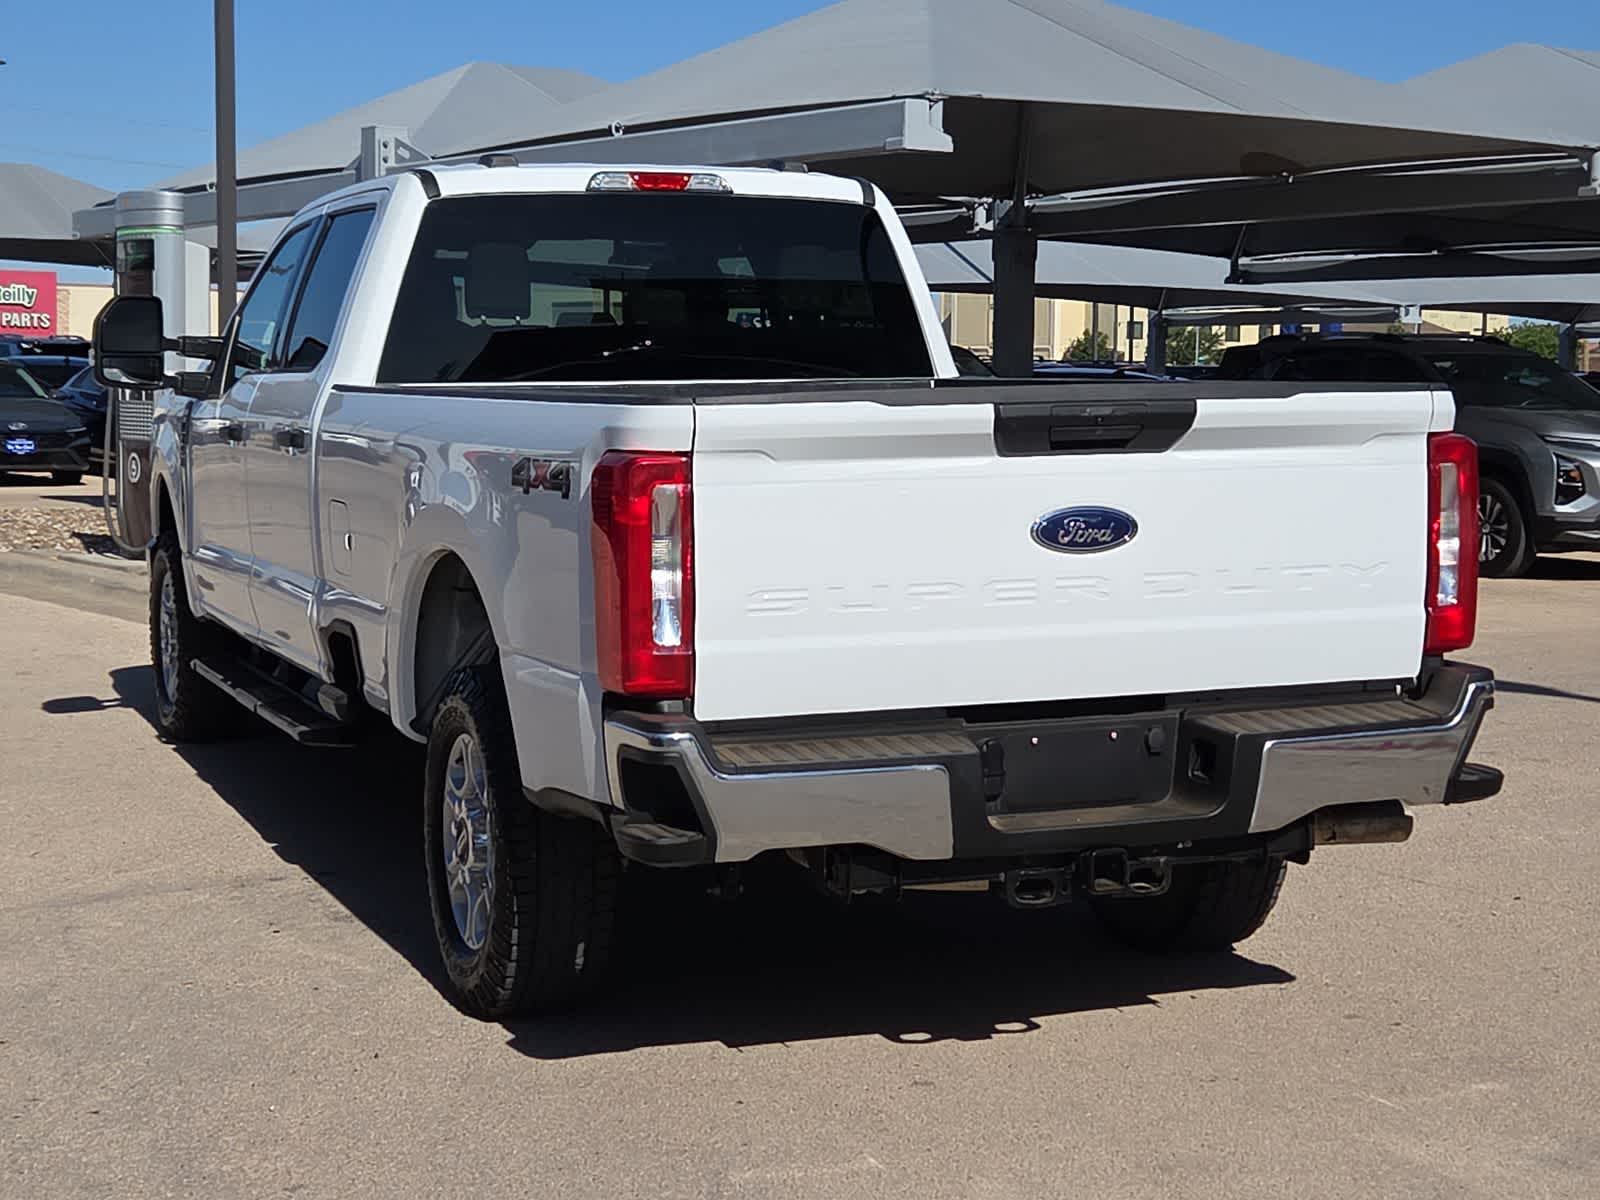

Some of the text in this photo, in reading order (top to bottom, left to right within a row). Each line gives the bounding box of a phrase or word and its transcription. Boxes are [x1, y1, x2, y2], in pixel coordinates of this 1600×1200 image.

[0, 284, 37, 306] eilly
[2, 312, 50, 328] PARTS
[1058, 516, 1114, 543] Ford
[745, 560, 1390, 616] SUPER DUTY
